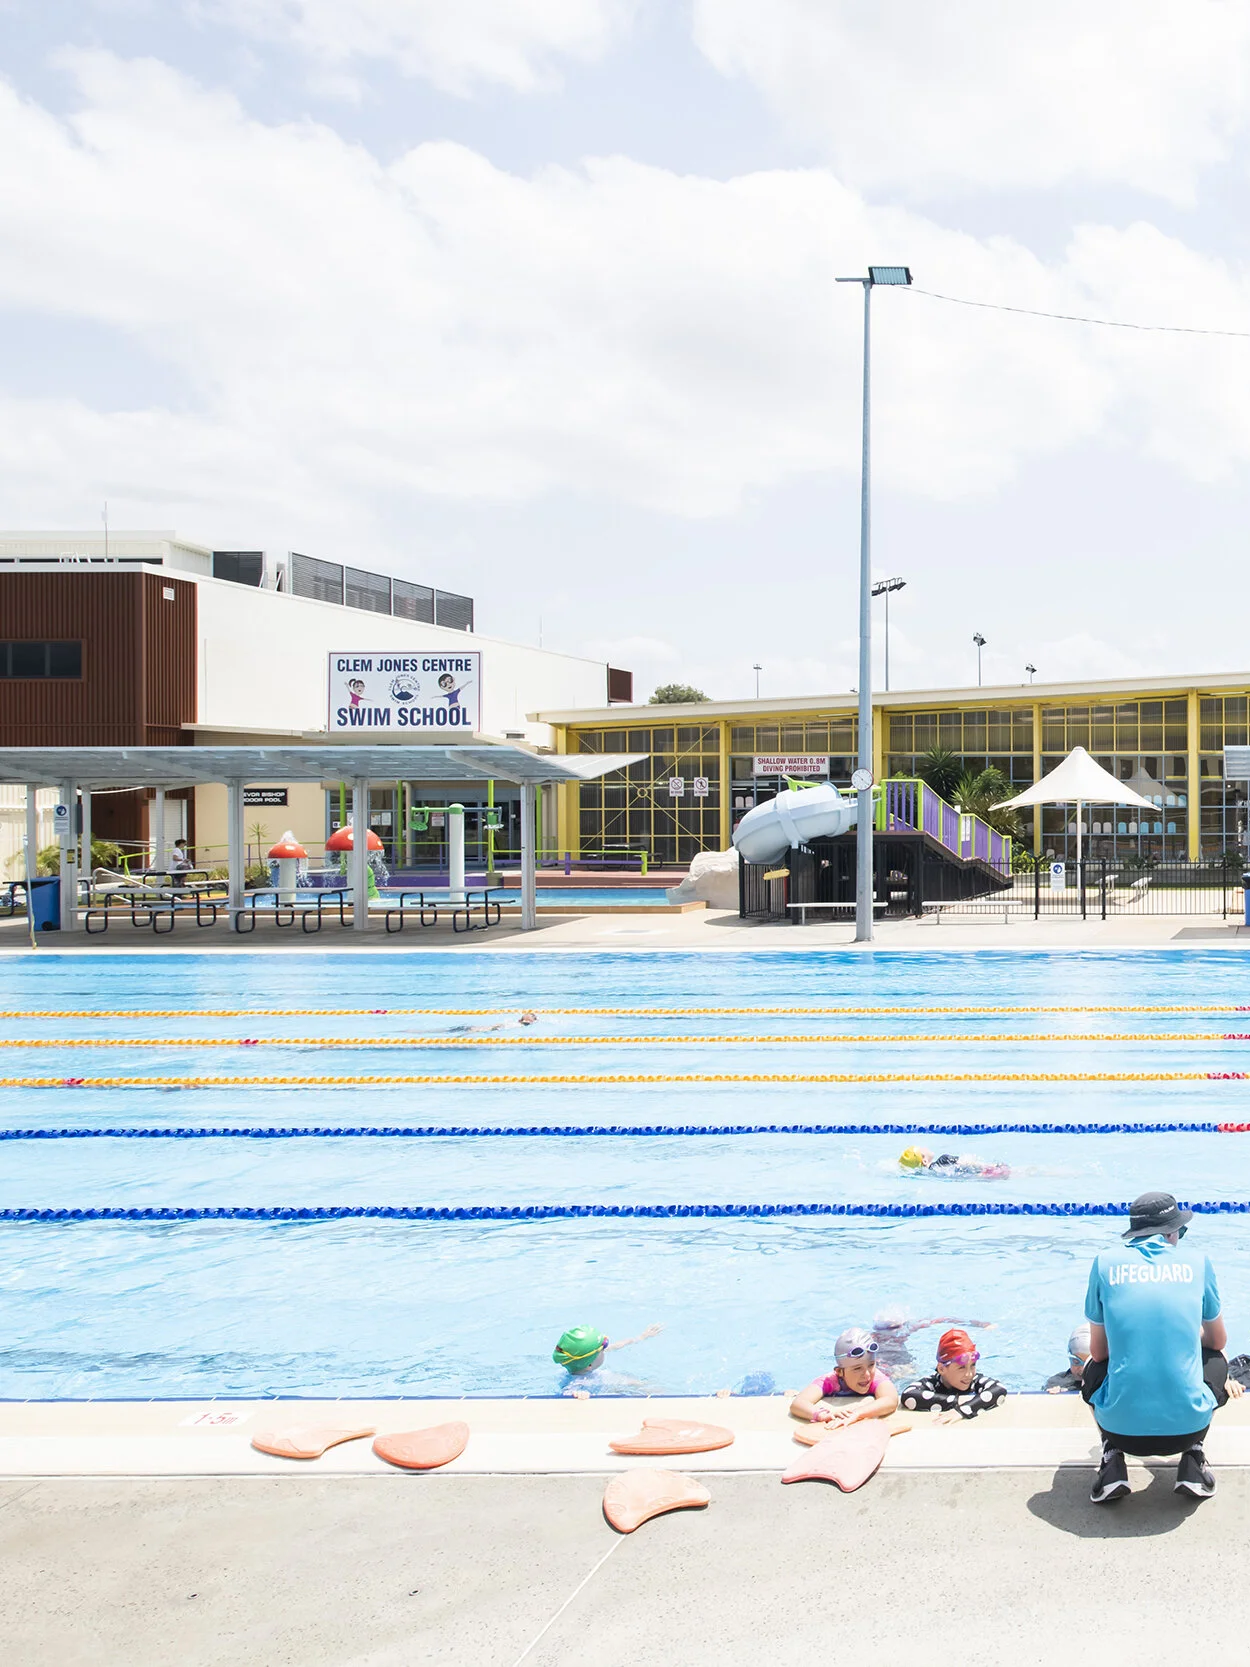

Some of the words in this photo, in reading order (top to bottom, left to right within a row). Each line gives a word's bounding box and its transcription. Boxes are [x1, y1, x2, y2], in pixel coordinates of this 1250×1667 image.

[337, 659, 372, 672] CLEM
[377, 659, 418, 672] JONES
[422, 659, 472, 672] CENTRE
[336, 707, 391, 726] SWIM
[397, 707, 472, 726] SCHOOL
[1109, 1263, 1193, 1286] LIFEGUARD
